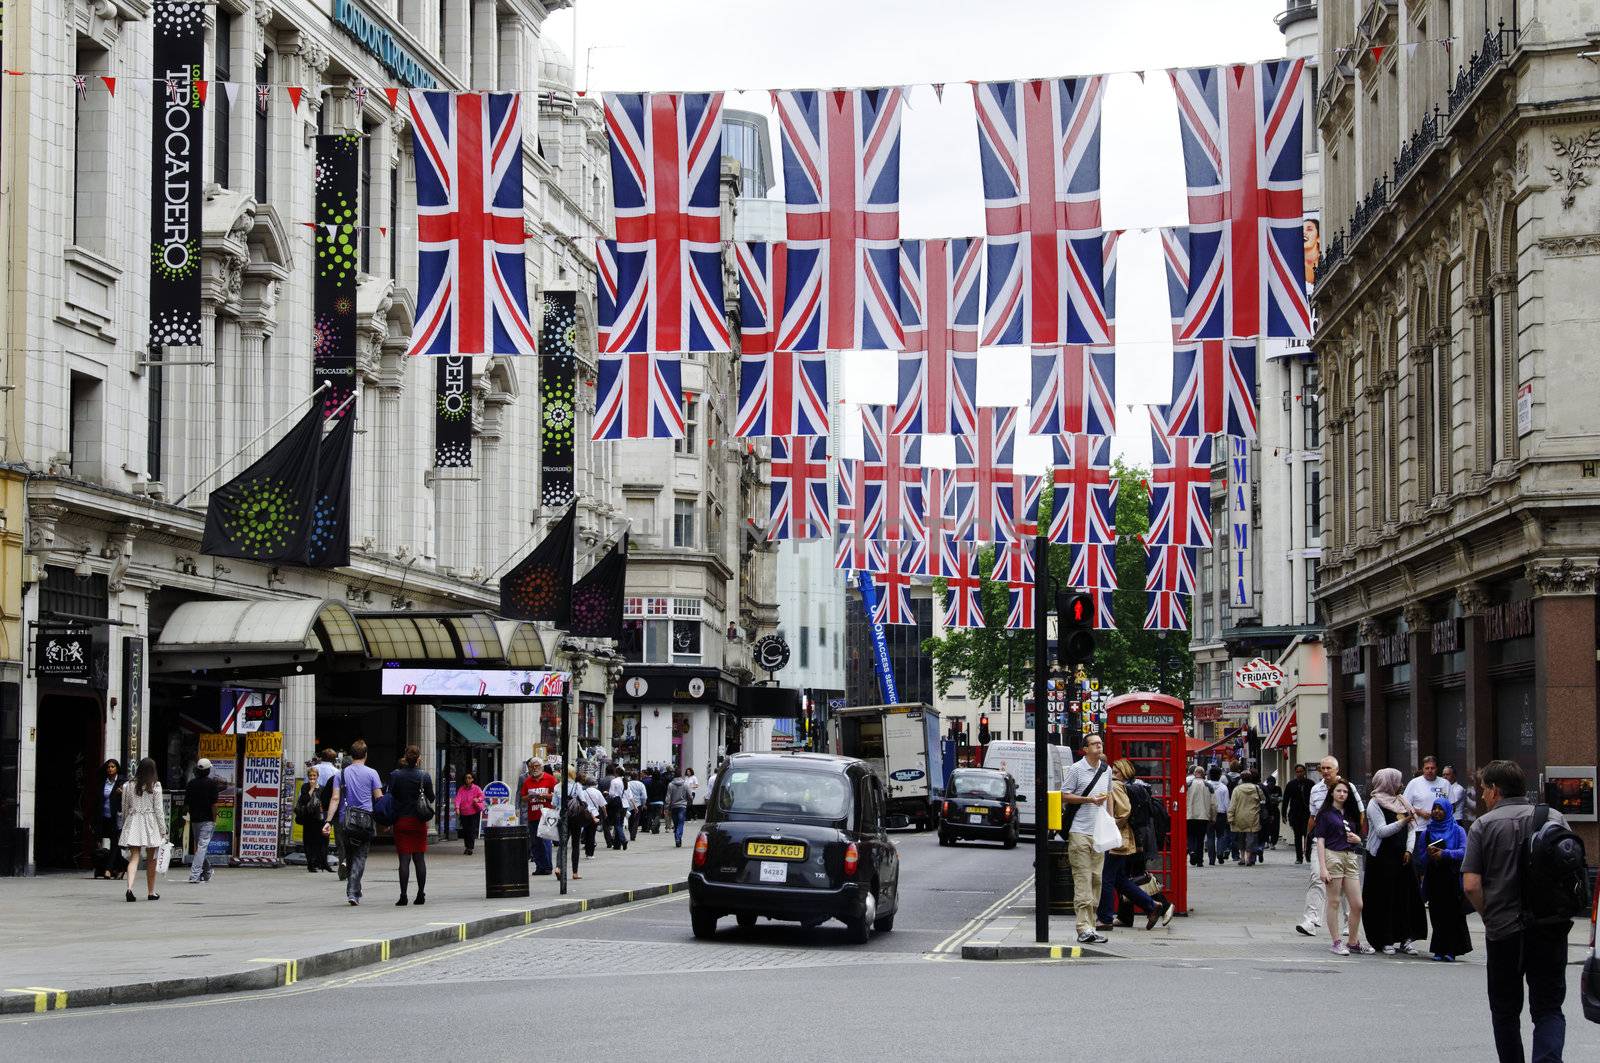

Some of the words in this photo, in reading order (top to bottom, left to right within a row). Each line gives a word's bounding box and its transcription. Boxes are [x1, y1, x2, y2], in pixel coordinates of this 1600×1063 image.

[164, 64, 191, 269] TROCADERO
[314, 367, 353, 375] TROCADERO
[1233, 523, 1248, 605] MIA
[878, 641, 890, 672] ACCESS
[1119, 715, 1172, 724] TELEPHONE
[246, 757, 280, 768] THEATRE
[246, 769, 279, 784] TICKETS
[752, 844, 778, 855] V262
[780, 845, 800, 856] KGU
